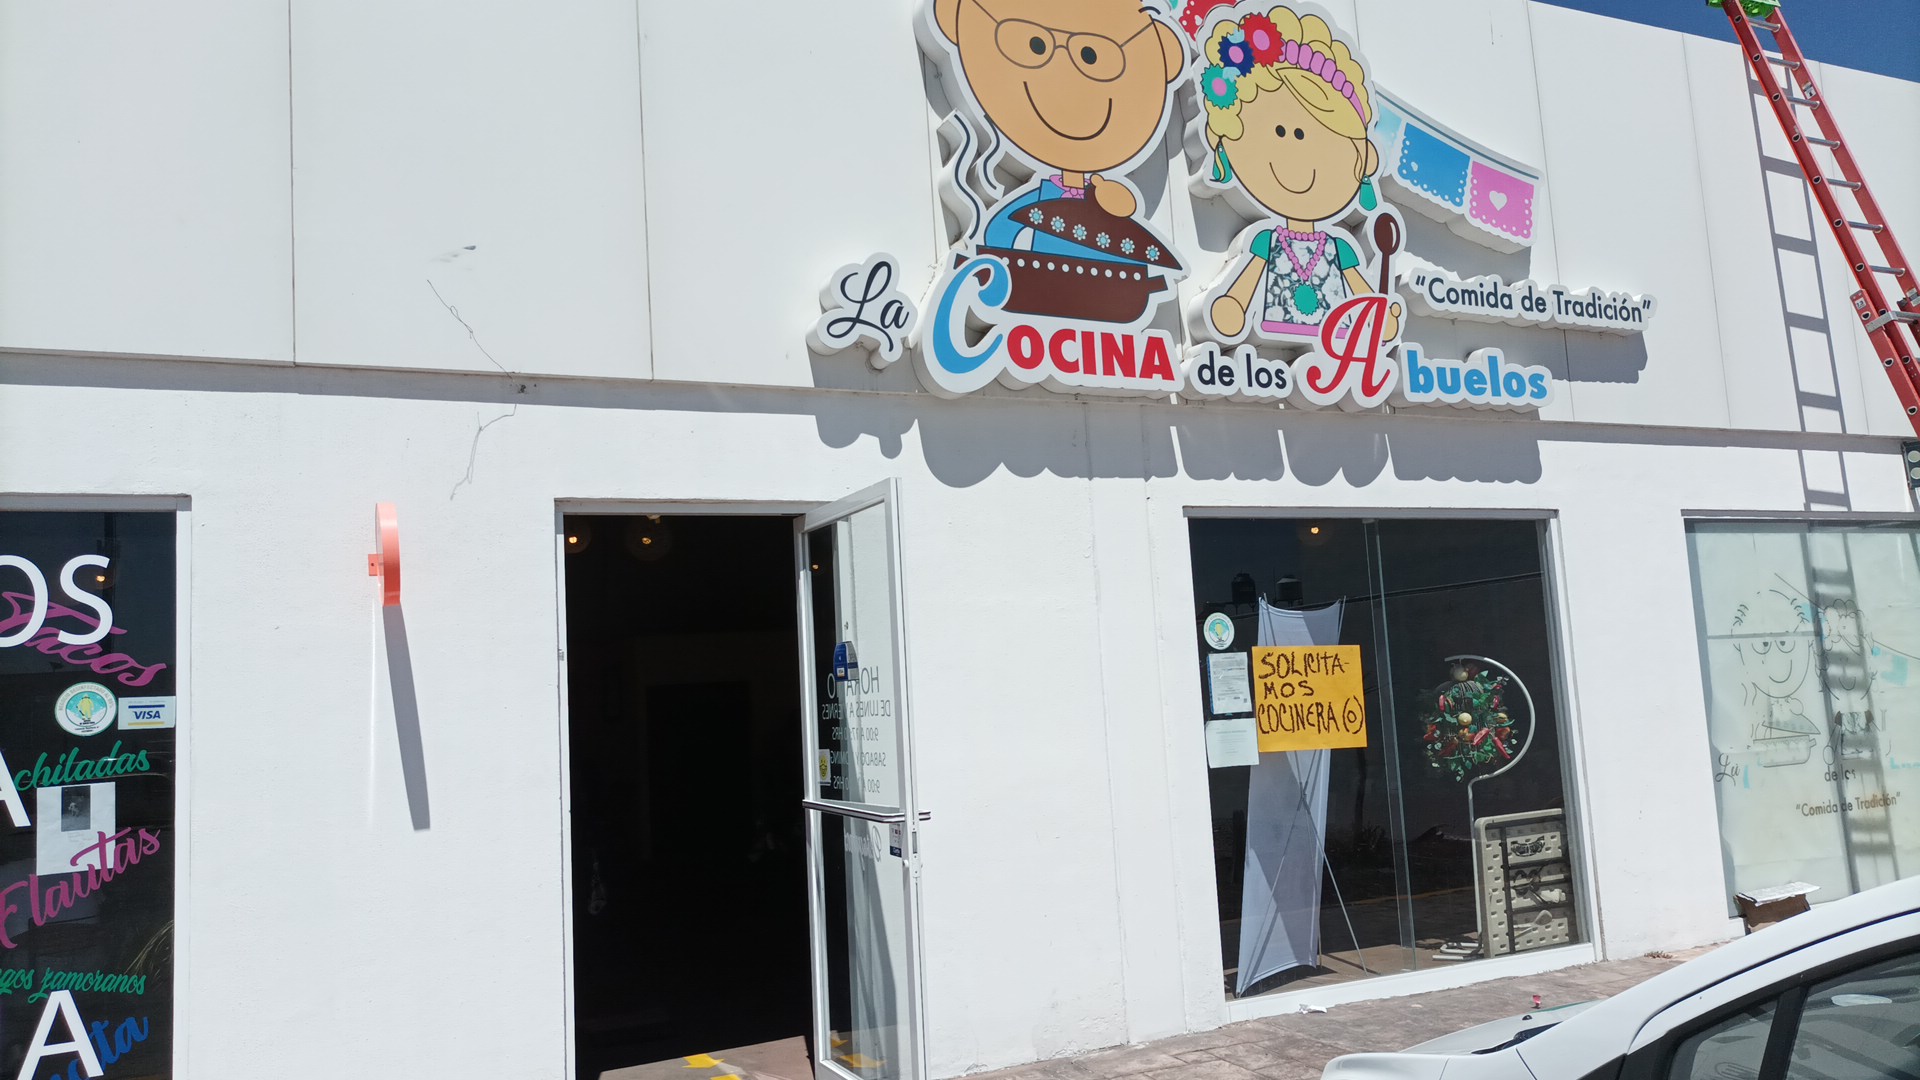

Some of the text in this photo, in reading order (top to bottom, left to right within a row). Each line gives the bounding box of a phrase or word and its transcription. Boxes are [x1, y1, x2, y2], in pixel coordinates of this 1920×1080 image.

[1520, 285, 1547, 313] de
[826, 260, 909, 352] La
[1197, 350, 1235, 386] de
[1246, 351, 1288, 390] los
[1263, 680, 1315, 700] MOS
[132, 710, 161, 720] VISA
[1824, 764, 1838, 782] de
[1840, 798, 1854, 813] de
[0, 968, 35, 996] gos
